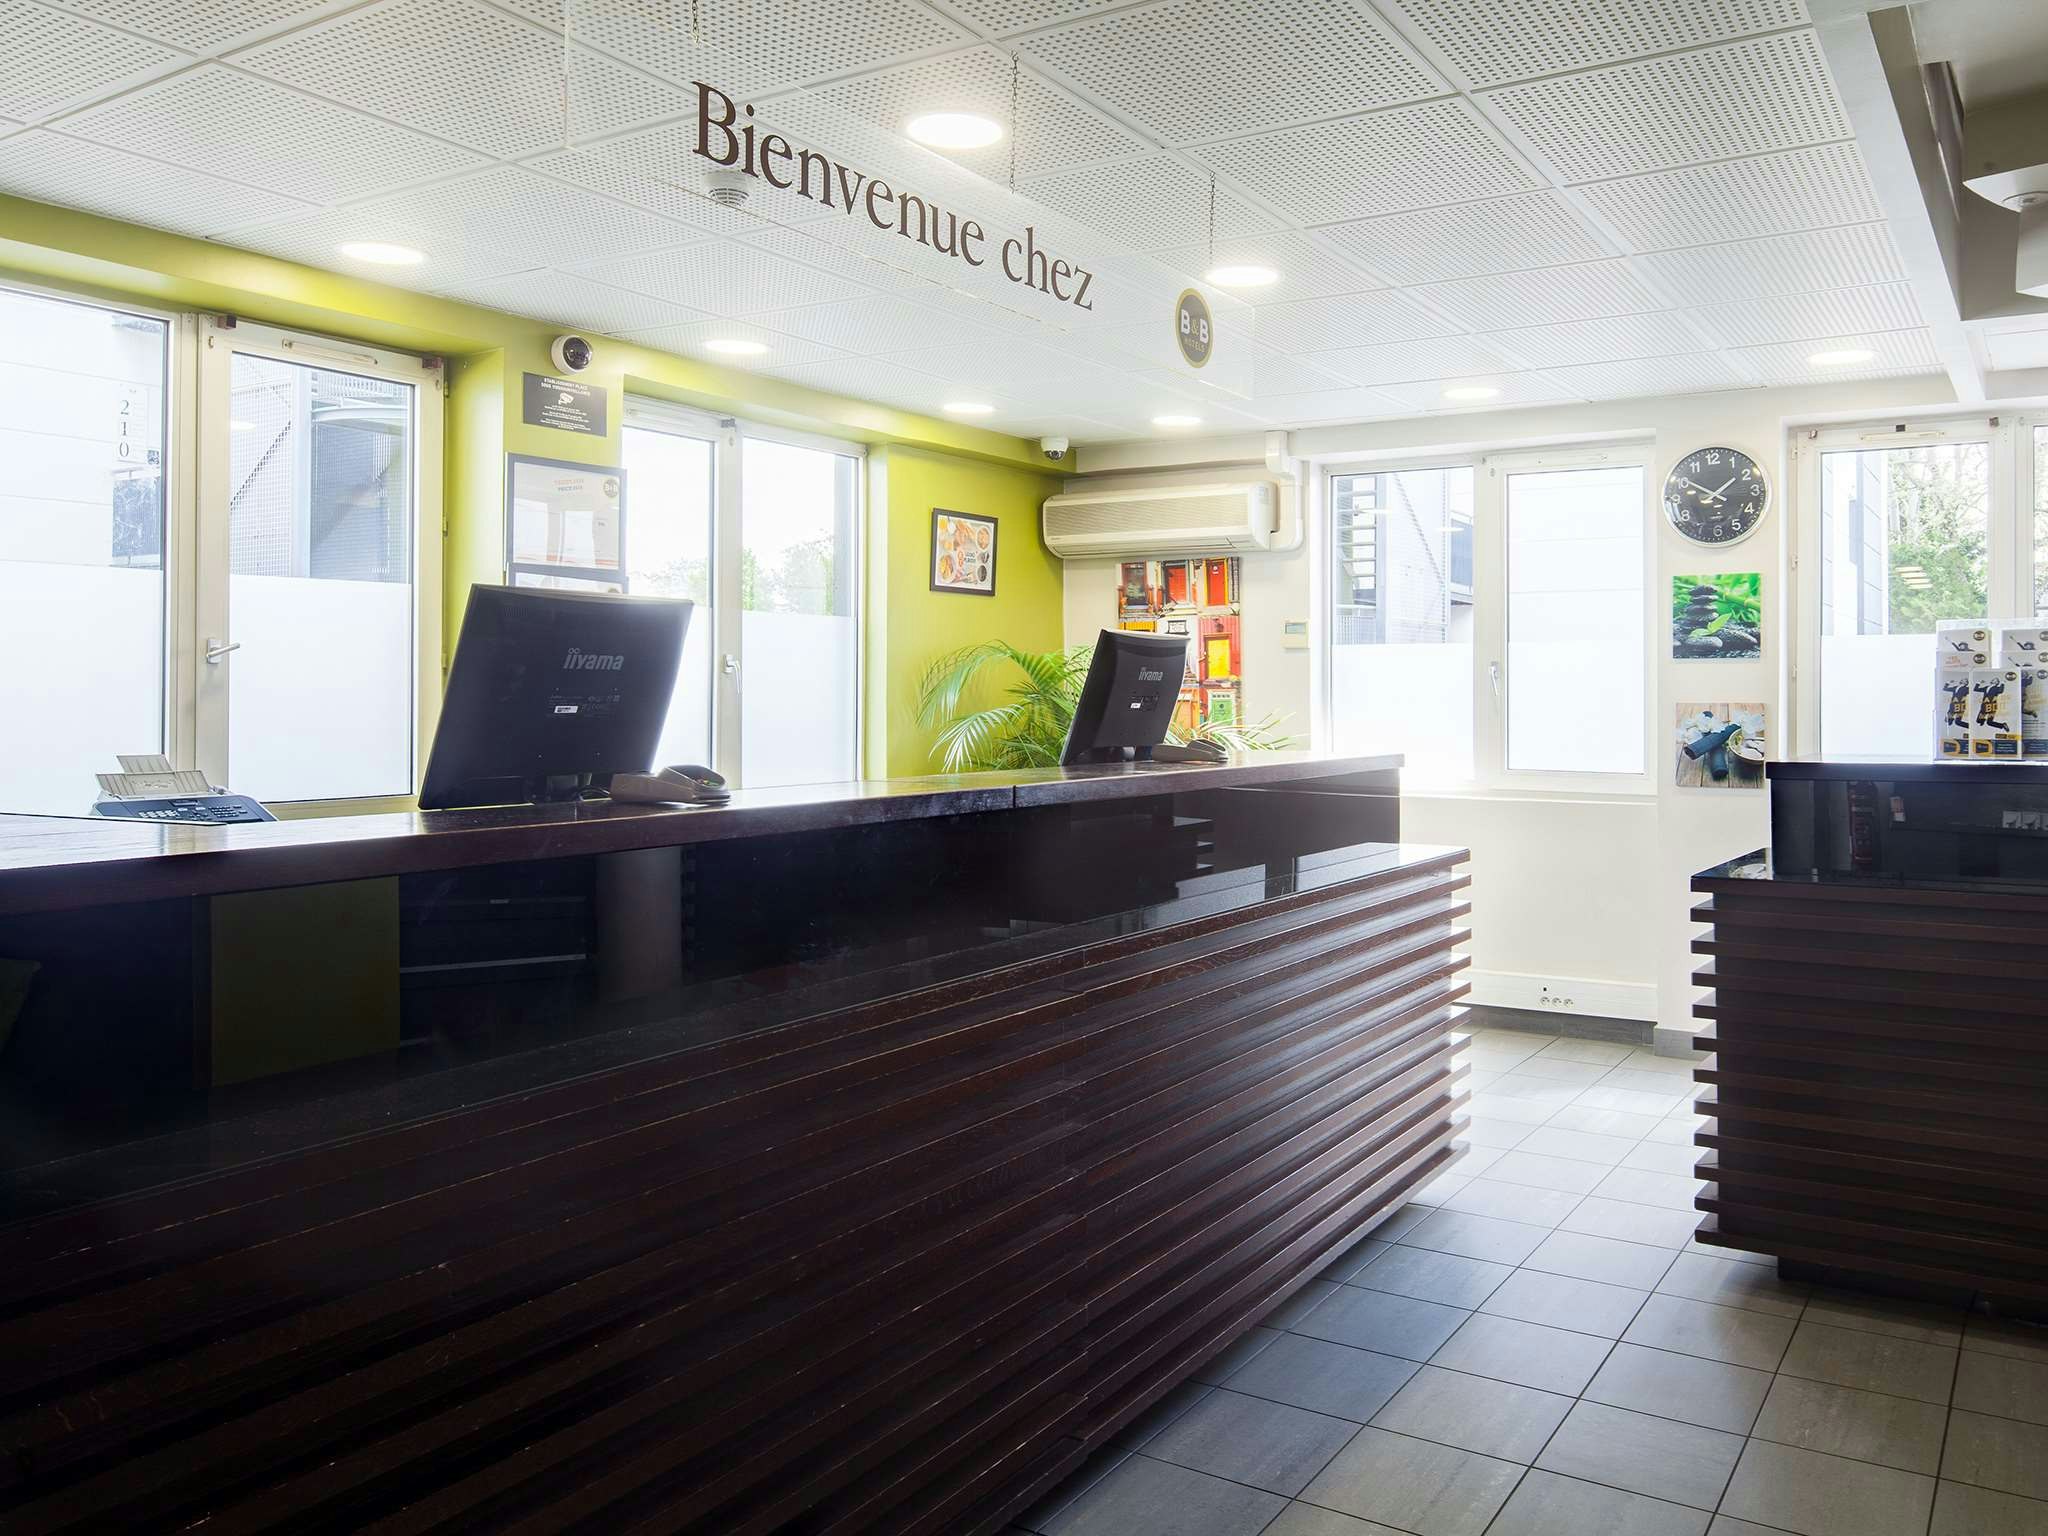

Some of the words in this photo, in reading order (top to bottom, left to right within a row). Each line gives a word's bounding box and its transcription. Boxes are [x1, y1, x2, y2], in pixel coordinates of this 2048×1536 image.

[692, 81, 984, 266] Bienvenue
[1001, 226, 1093, 311] chez
[1181, 309, 1209, 344] B&B
[1705, 453, 1720, 465] 12
[1729, 456, 1735, 469] 1
[1690, 462, 1700, 473] 11
[1742, 469, 1751, 481] 2
[1750, 484, 1760, 496] 3
[1671, 494, 1680, 505] 9
[1744, 502, 1754, 514] 4
[1681, 509, 1690, 522] 8
[1696, 522, 1704, 534] 7
[1731, 518, 1741, 531] 5
[1713, 525, 1722, 537] 6
[563, 648, 624, 670] iiyama
[1139, 667, 1163, 681] iiyama
